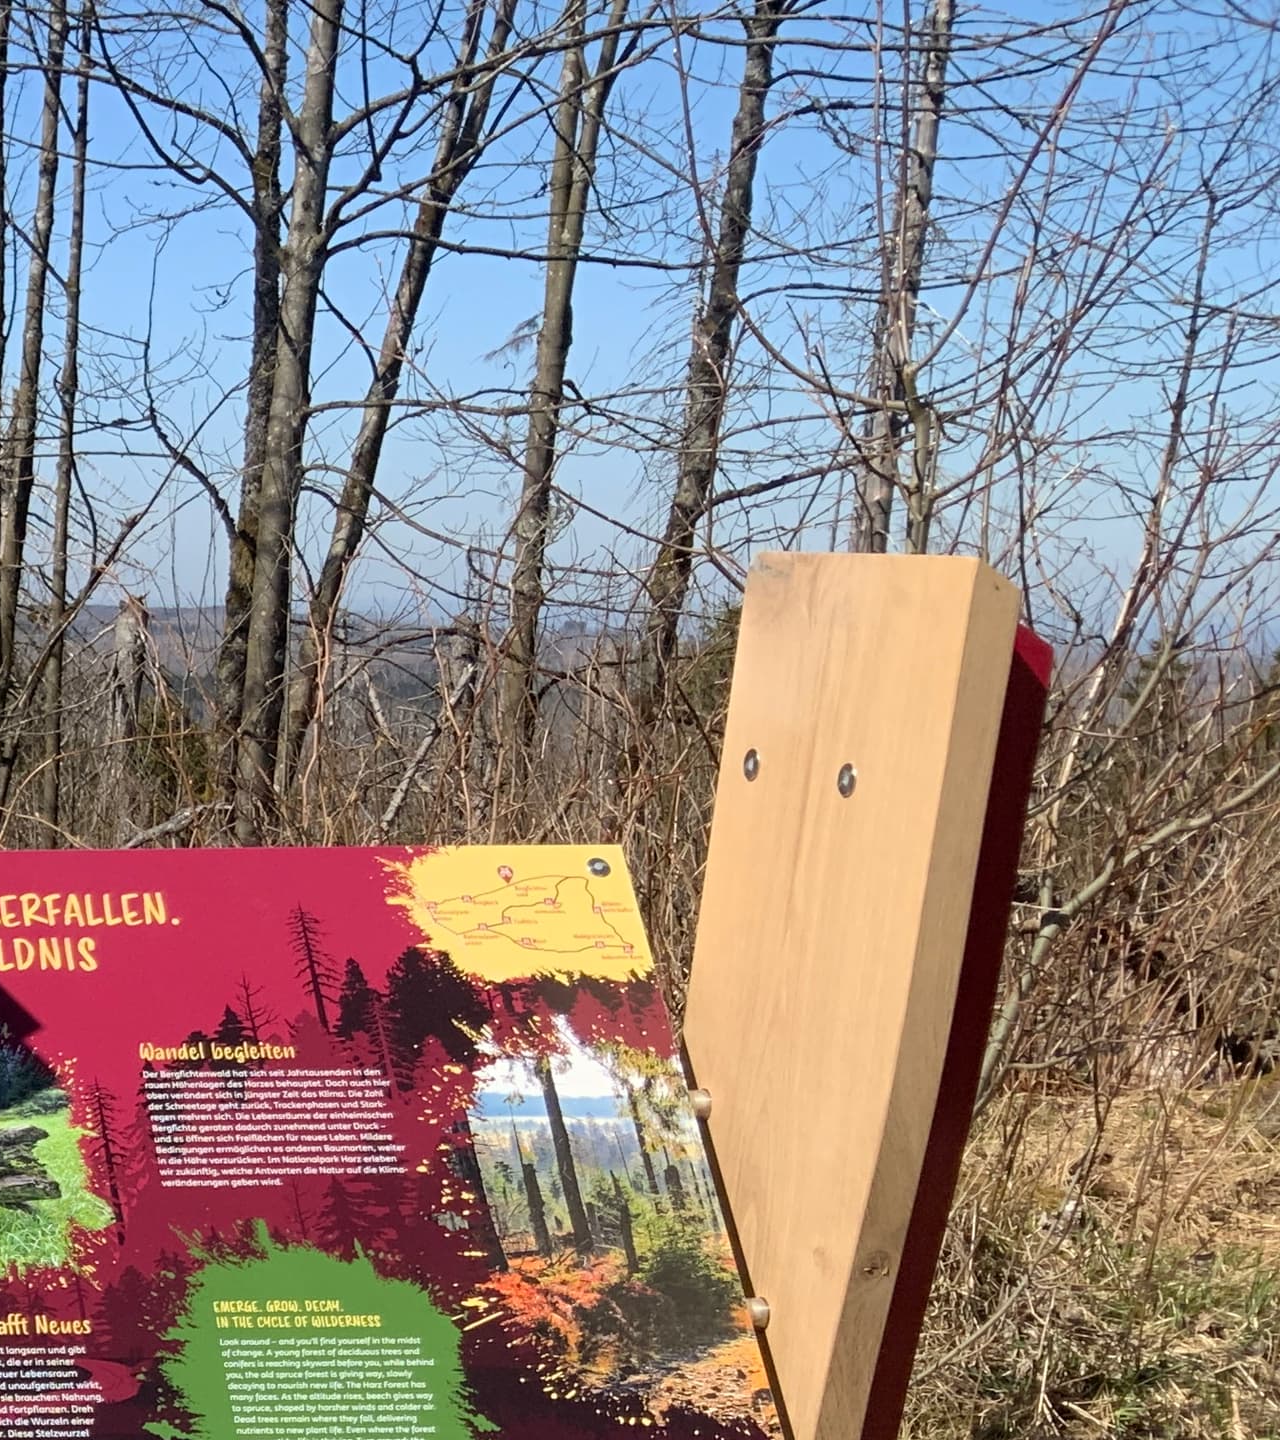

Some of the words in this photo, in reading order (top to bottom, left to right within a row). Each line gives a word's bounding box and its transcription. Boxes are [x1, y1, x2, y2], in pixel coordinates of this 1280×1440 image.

[139, 1042, 205, 1061] Wandel
[211, 1042, 295, 1063] begleiten
[213, 1300, 262, 1313] EMERGE.
[266, 1300, 302, 1312] GROW.
[305, 1300, 344, 1312] DECAY.
[35, 1315, 92, 1335] Neues
[216, 1316, 229, 1328] IN
[232, 1316, 254, 1328] THE
[257, 1316, 291, 1328] CYCLE
[294, 1316, 308, 1328] OF
[311, 1315, 381, 1327] WILDERNESS
